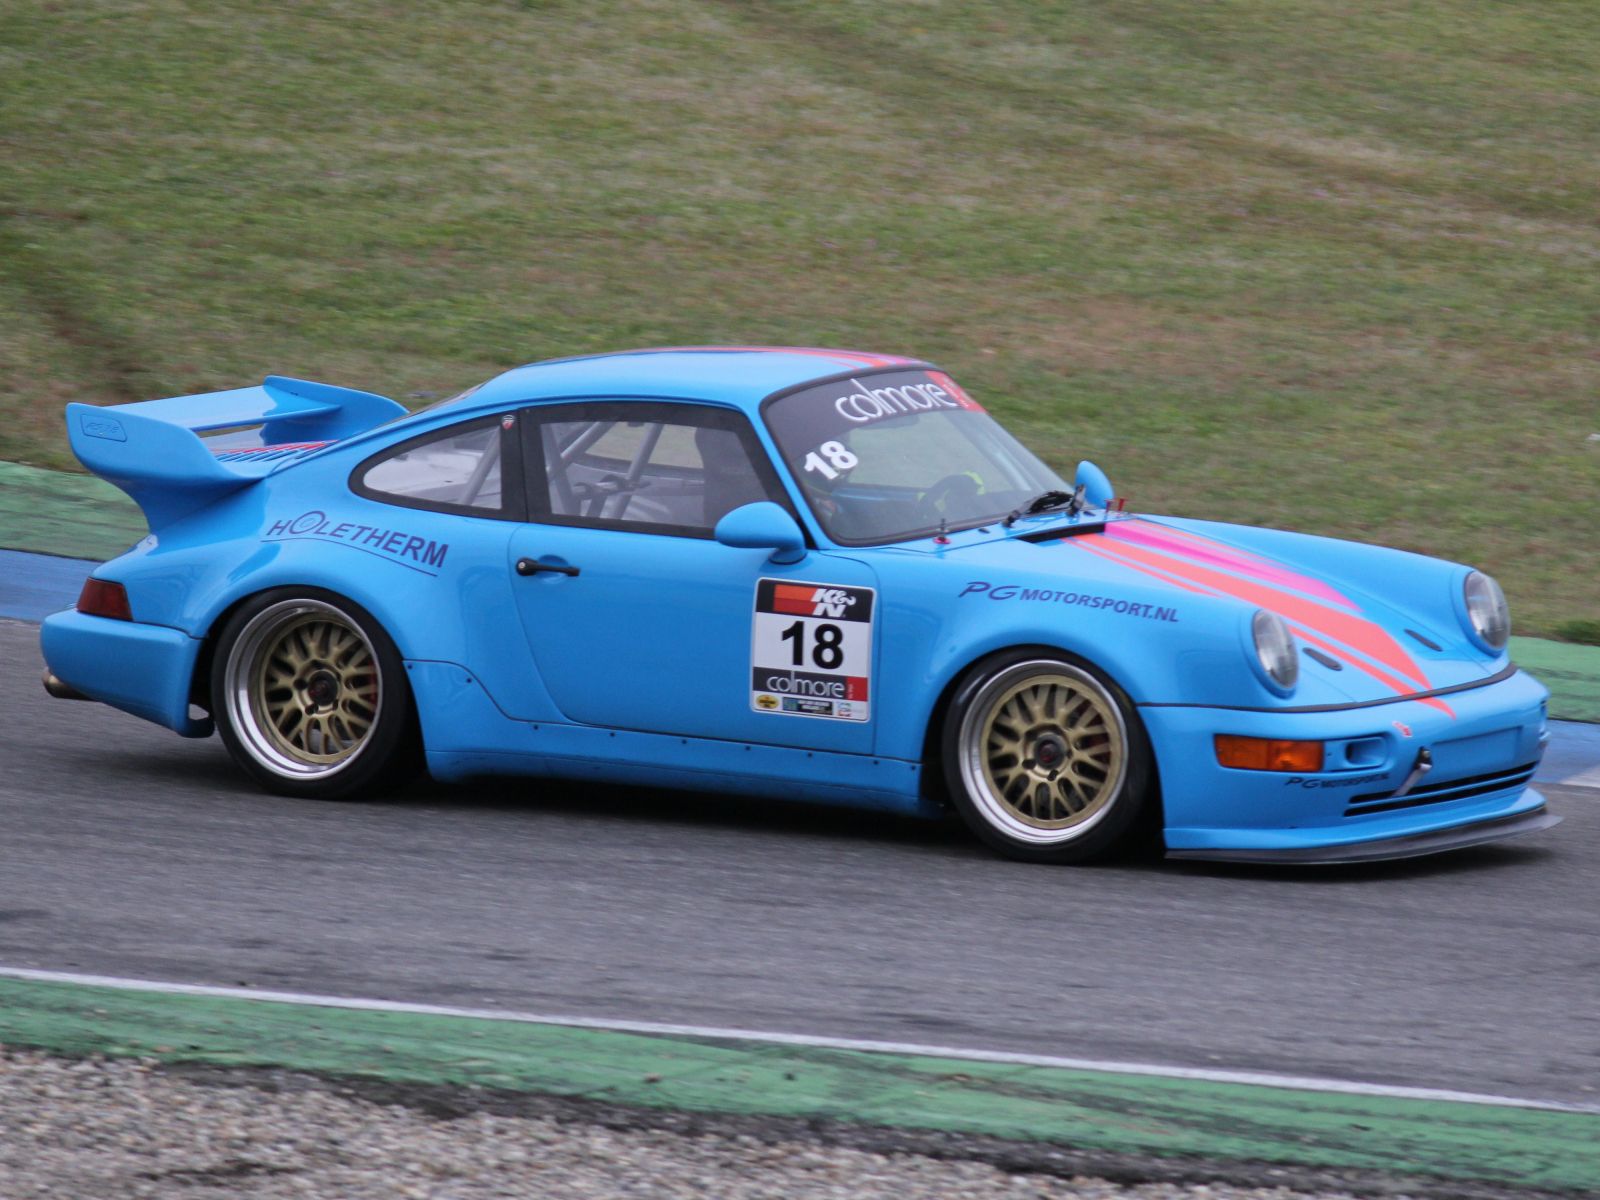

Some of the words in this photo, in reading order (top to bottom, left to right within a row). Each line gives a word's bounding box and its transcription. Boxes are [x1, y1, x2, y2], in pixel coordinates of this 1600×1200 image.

[834, 378, 959, 422] colmore
[804, 440, 859, 480] 18
[265, 510, 450, 569] HOLETHERM
[957, 580, 1021, 601] PG
[1019, 588, 1180, 623] MOTORSPORT.NL
[781, 620, 844, 670] 18
[766, 670, 845, 698] colmore
